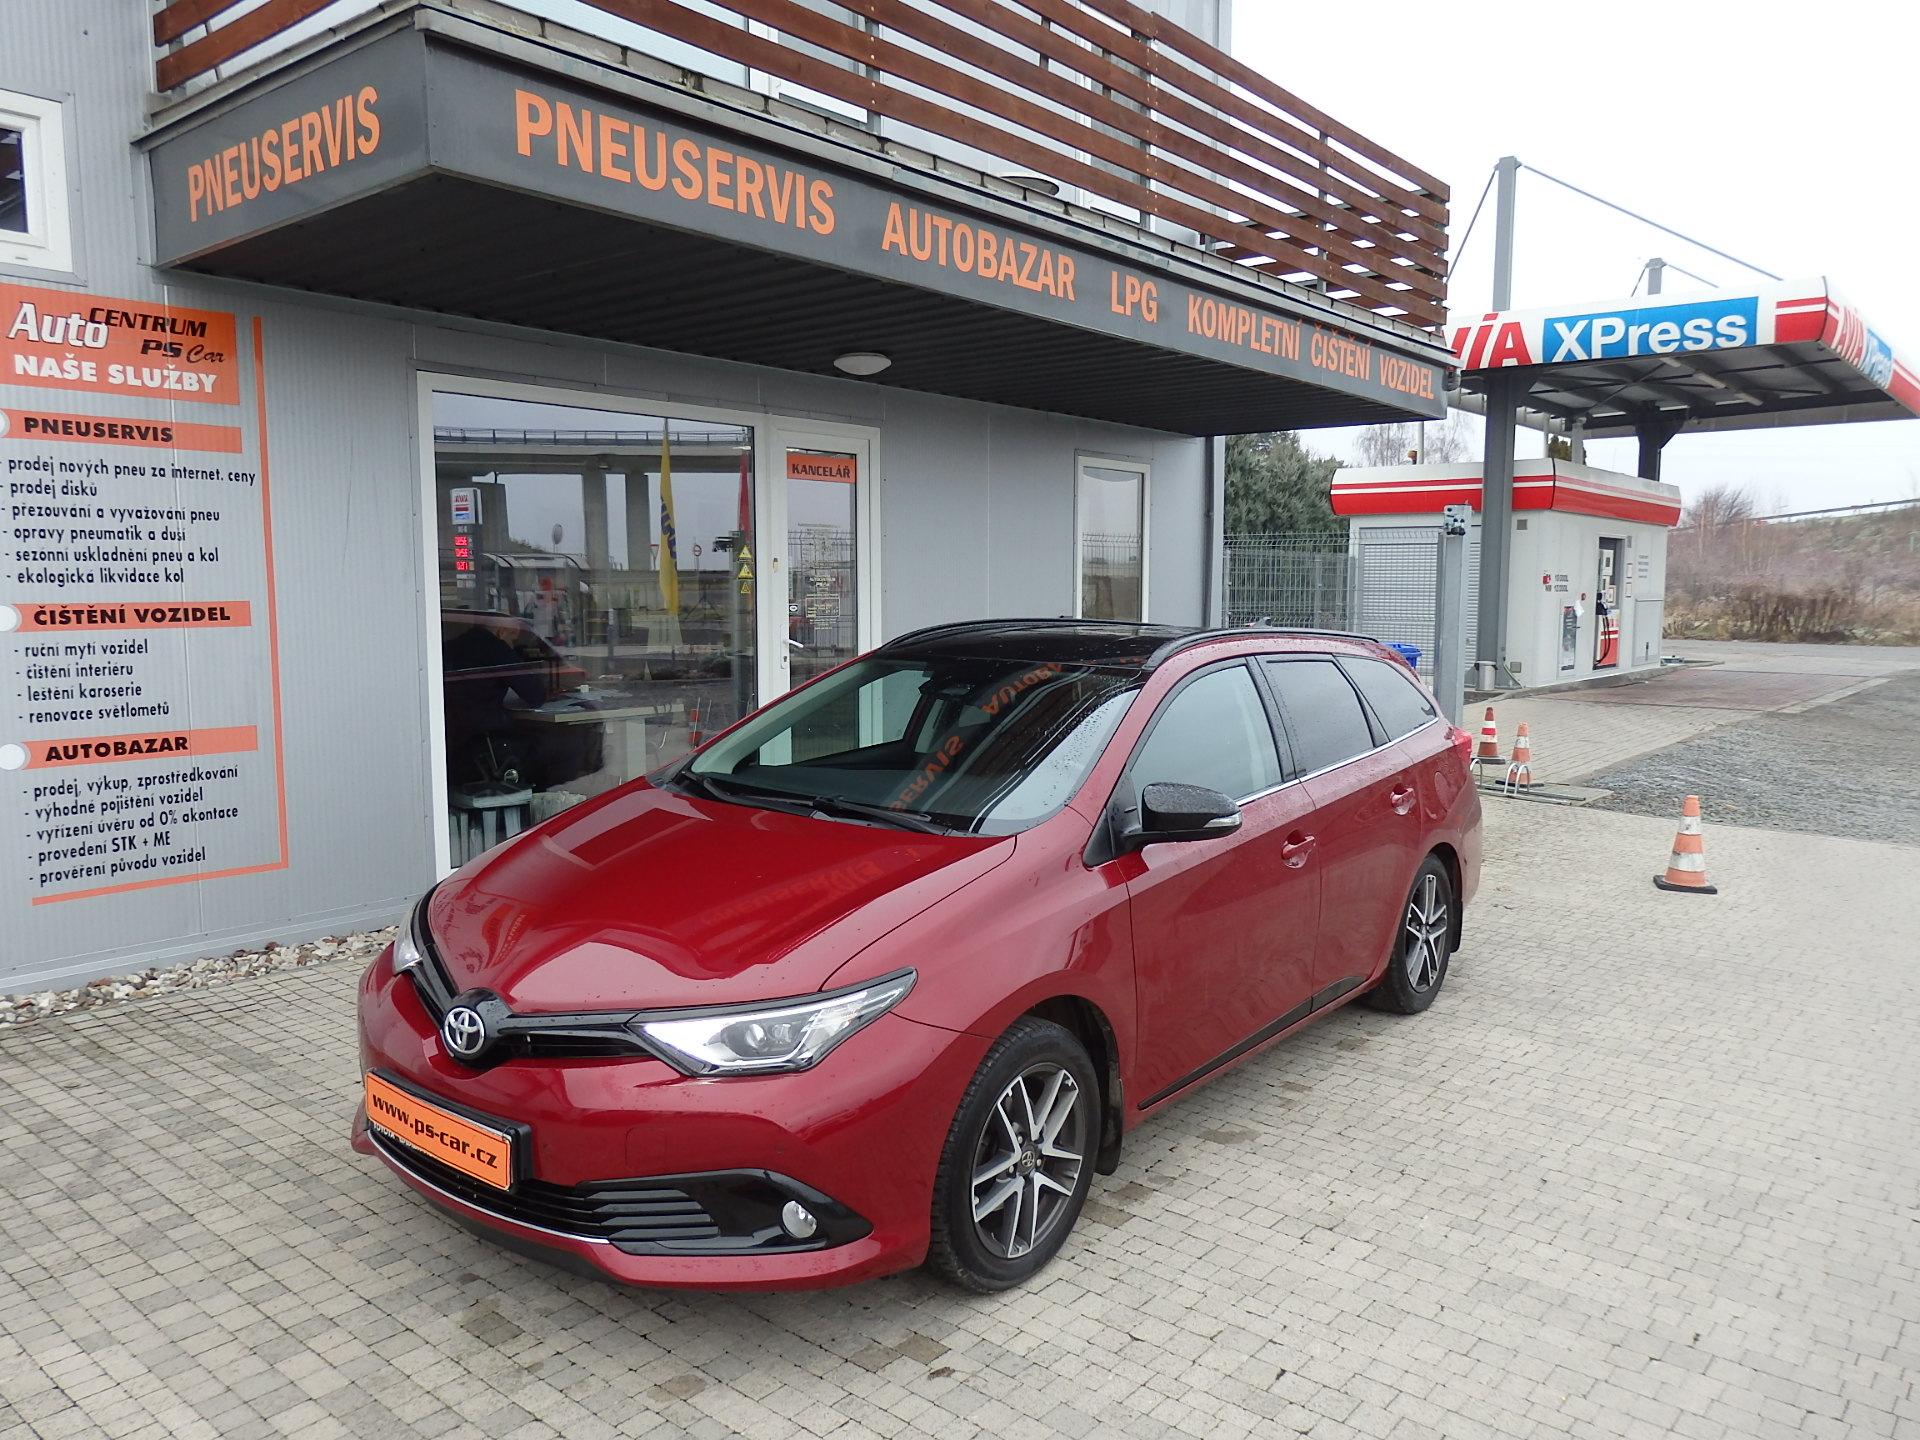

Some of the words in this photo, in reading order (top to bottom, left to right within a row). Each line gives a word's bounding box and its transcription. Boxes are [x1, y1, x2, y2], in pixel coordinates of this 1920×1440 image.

[187, 86, 380, 223] PNEUSERVIS
[515, 88, 836, 235] PNEUSERVIS
[881, 202, 1076, 301] AUTOBAZAR
[1110, 271, 1158, 323] LPG
[1187, 294, 1303, 361] KOMPLETNÍ
[1310, 321, 1375, 381] ČIŠTĚNÍ
[1379, 353, 1435, 400] VOZIDEL
[7, 301, 110, 350] Auto
[90, 308, 207, 338] CENTRUM
[1552, 314, 1748, 362] XPress
[141, 339, 183, 358] PS
[187, 344, 226, 364] Car
[14, 352, 98, 383] NAŠE
[108, 364, 218, 393] SLUŽBY
[24, 417, 173, 443] PNEUSERVIS
[8, 456, 55, 477] prodej
[59, 458, 109, 479] nových
[114, 462, 146, 479] pneu
[151, 465, 167, 478] za
[171, 463, 224, 481] internet.
[228, 471, 256, 486] ceny
[791, 463, 851, 479] KANCELÁŘ
[10, 480, 57, 499] prodej
[61, 481, 98, 497] disků
[12, 504, 91, 521] přezouvání
[97, 507, 105, 519] a
[110, 505, 187, 523] vyvažování
[190, 509, 220, 523] pneu
[14, 528, 65, 544] opravy
[70, 525, 143, 544] pneumatik
[148, 529, 156, 541] a
[161, 526, 187, 542] duší
[16, 547, 70, 562] sezónní
[74, 546, 148, 562] uskladnění
[152, 551, 183, 566] pneu
[187, 551, 195, 563] a
[200, 547, 219, 562] kol
[17, 568, 95, 588] ekologická
[99, 568, 160, 584] likvidace
[165, 568, 184, 583] kol
[34, 604, 127, 626] ČIŠTĚNÍ
[134, 606, 231, 624] VOZIDEL
[25, 642, 60, 658] ruční
[101, 638, 149, 656] vozidel
[26, 663, 71, 680] čištění
[75, 661, 134, 679] interiéru
[28, 685, 74, 701] leštění
[79, 683, 142, 699] karoserie
[29, 708, 93, 724] renovace
[98, 702, 170, 720] světlometů
[45, 736, 189, 762] AUTOBAZAR
[34, 779, 82, 800] prodej,
[87, 775, 133, 796] výkup,
[137, 765, 239, 790] zprostředkování
[36, 801, 95, 822] výhodné
[101, 794, 155, 816] pojištění
[159, 786, 204, 805] vozidel
[37, 823, 93, 843] vyřízení
[98, 817, 135, 834] úvěru
[139, 812, 155, 829] od
[159, 810, 179, 826] 0%
[182, 806, 239, 824] akontace
[38, 844, 107, 866] provedení
[112, 836, 137, 852] STK
[153, 831, 172, 847] ME
[40, 864, 107, 887] prověření
[111, 855, 158, 877] původu
[162, 848, 207, 867] vozidel
[372, 1093, 498, 1169] www.ps-car.cz
